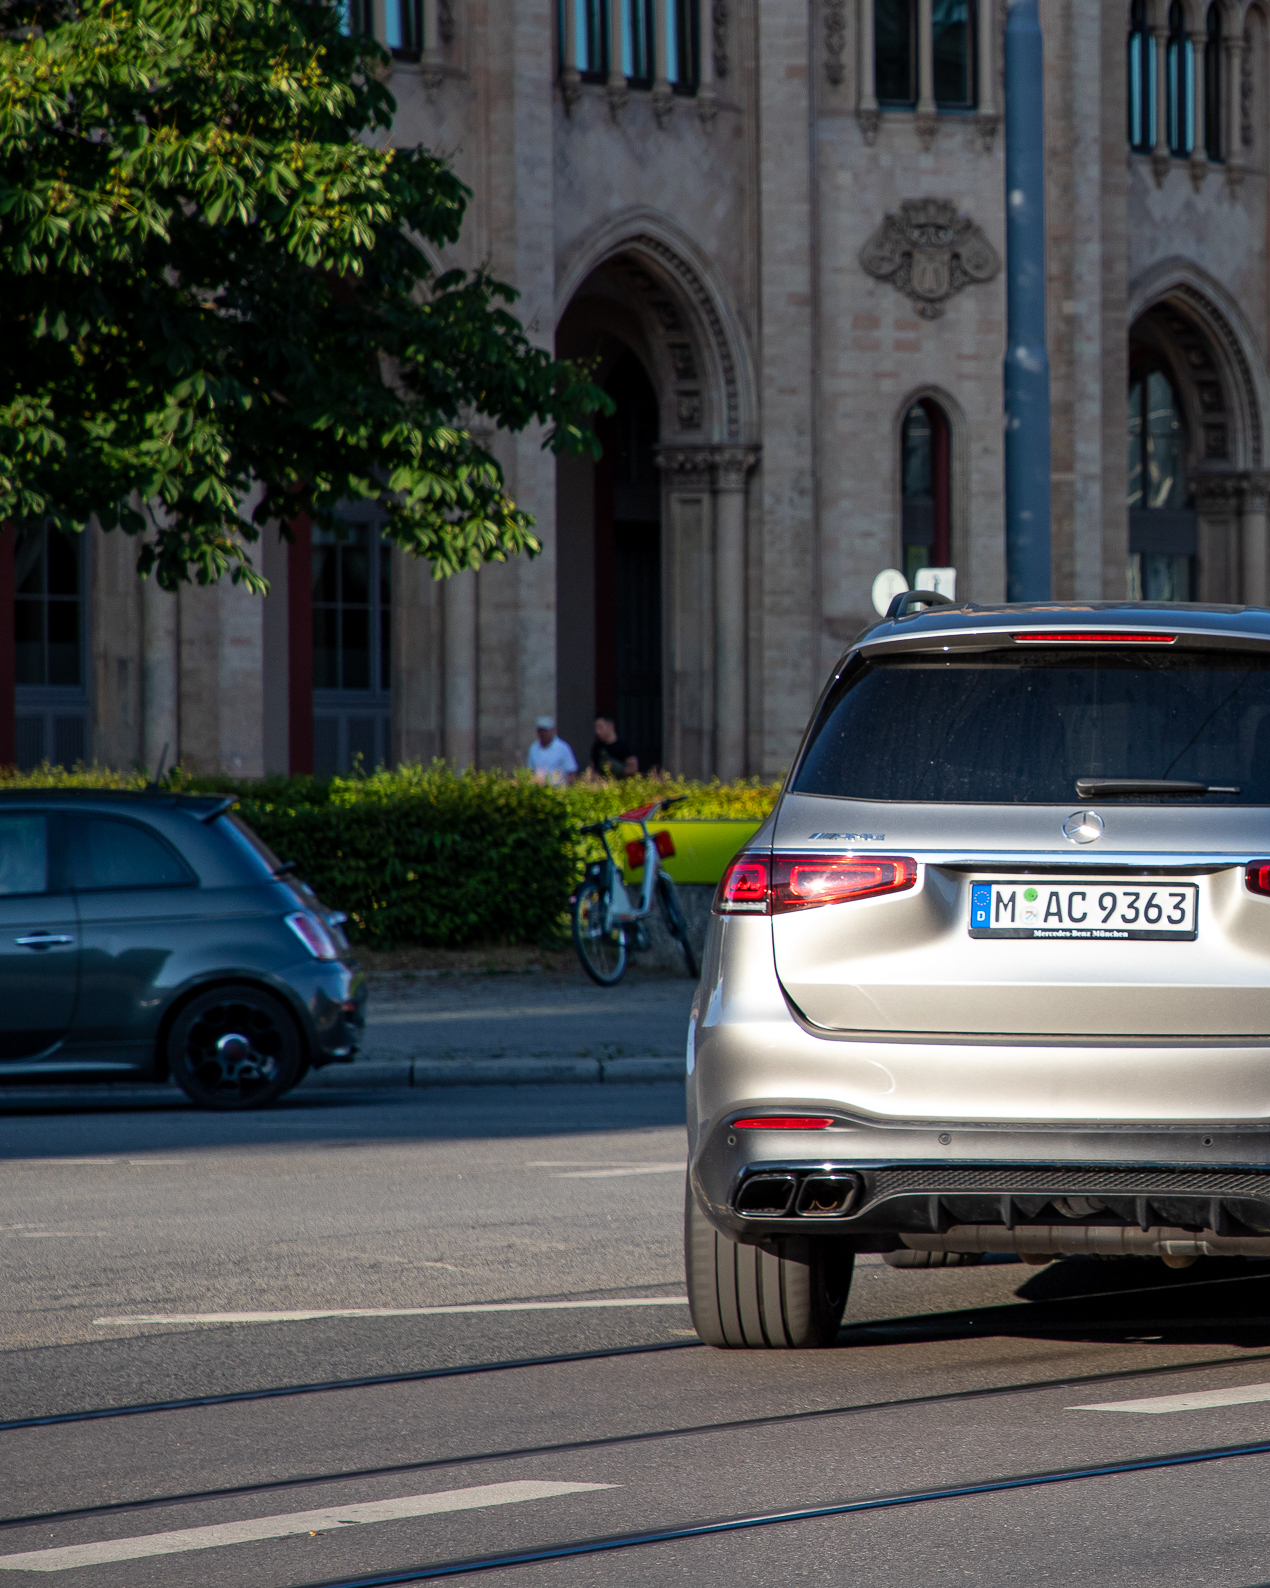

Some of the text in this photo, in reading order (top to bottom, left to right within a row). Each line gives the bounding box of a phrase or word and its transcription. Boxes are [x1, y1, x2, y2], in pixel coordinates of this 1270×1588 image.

[995, 891, 1187, 925] M AC 9363
[977, 911, 986, 921] D
[1033, 929, 1129, 938] Mercedes-Benz München
